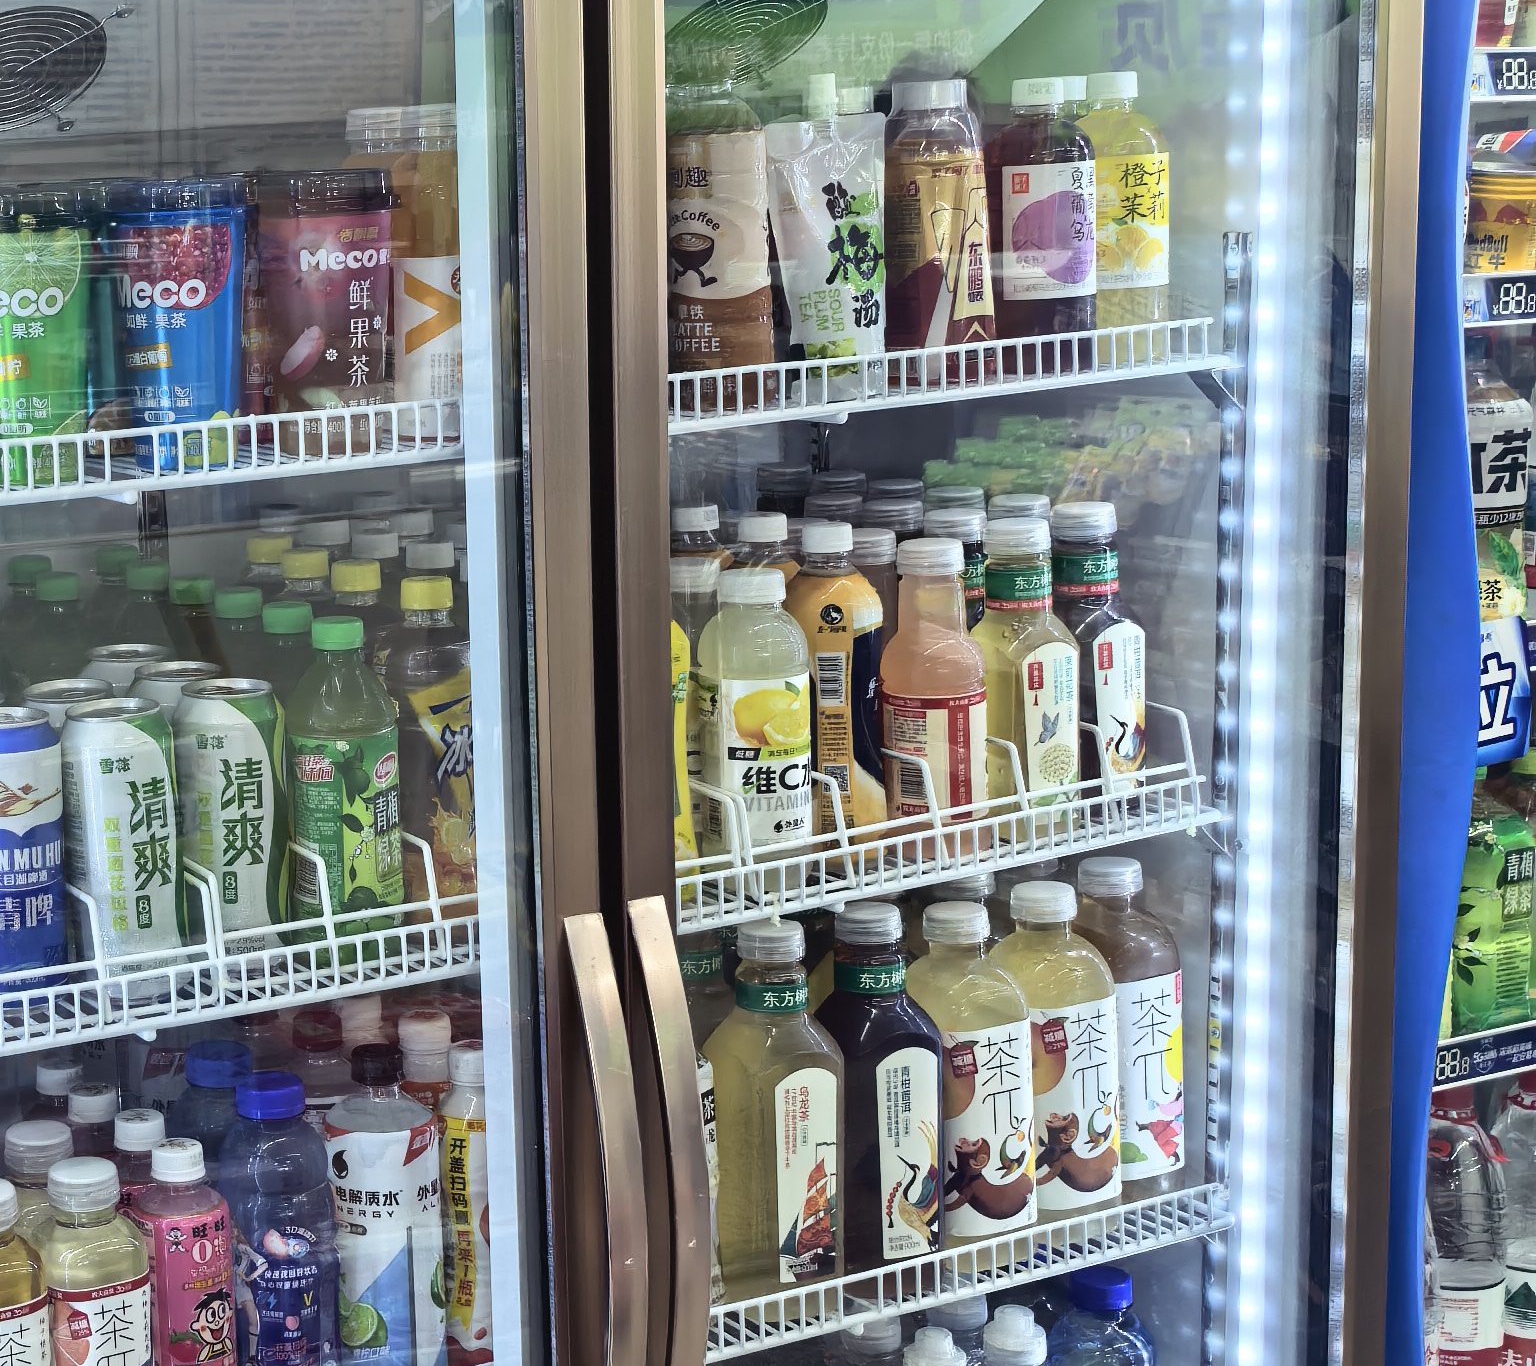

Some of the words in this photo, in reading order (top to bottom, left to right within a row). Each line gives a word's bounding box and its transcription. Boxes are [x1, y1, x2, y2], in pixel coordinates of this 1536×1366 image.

[118, 275, 207, 309] Meco
[799, 293, 814, 322] TEA
[814, 290, 829, 331] PLUM
[829, 289, 845, 332] SOUR
[347, 276, 373, 388] 鲜果茶
[219, 757, 265, 867] 清爽
[126, 776, 173, 892] 清爽
[14, 845, 43, 871] MU
[45, 841, 62, 867] HU
